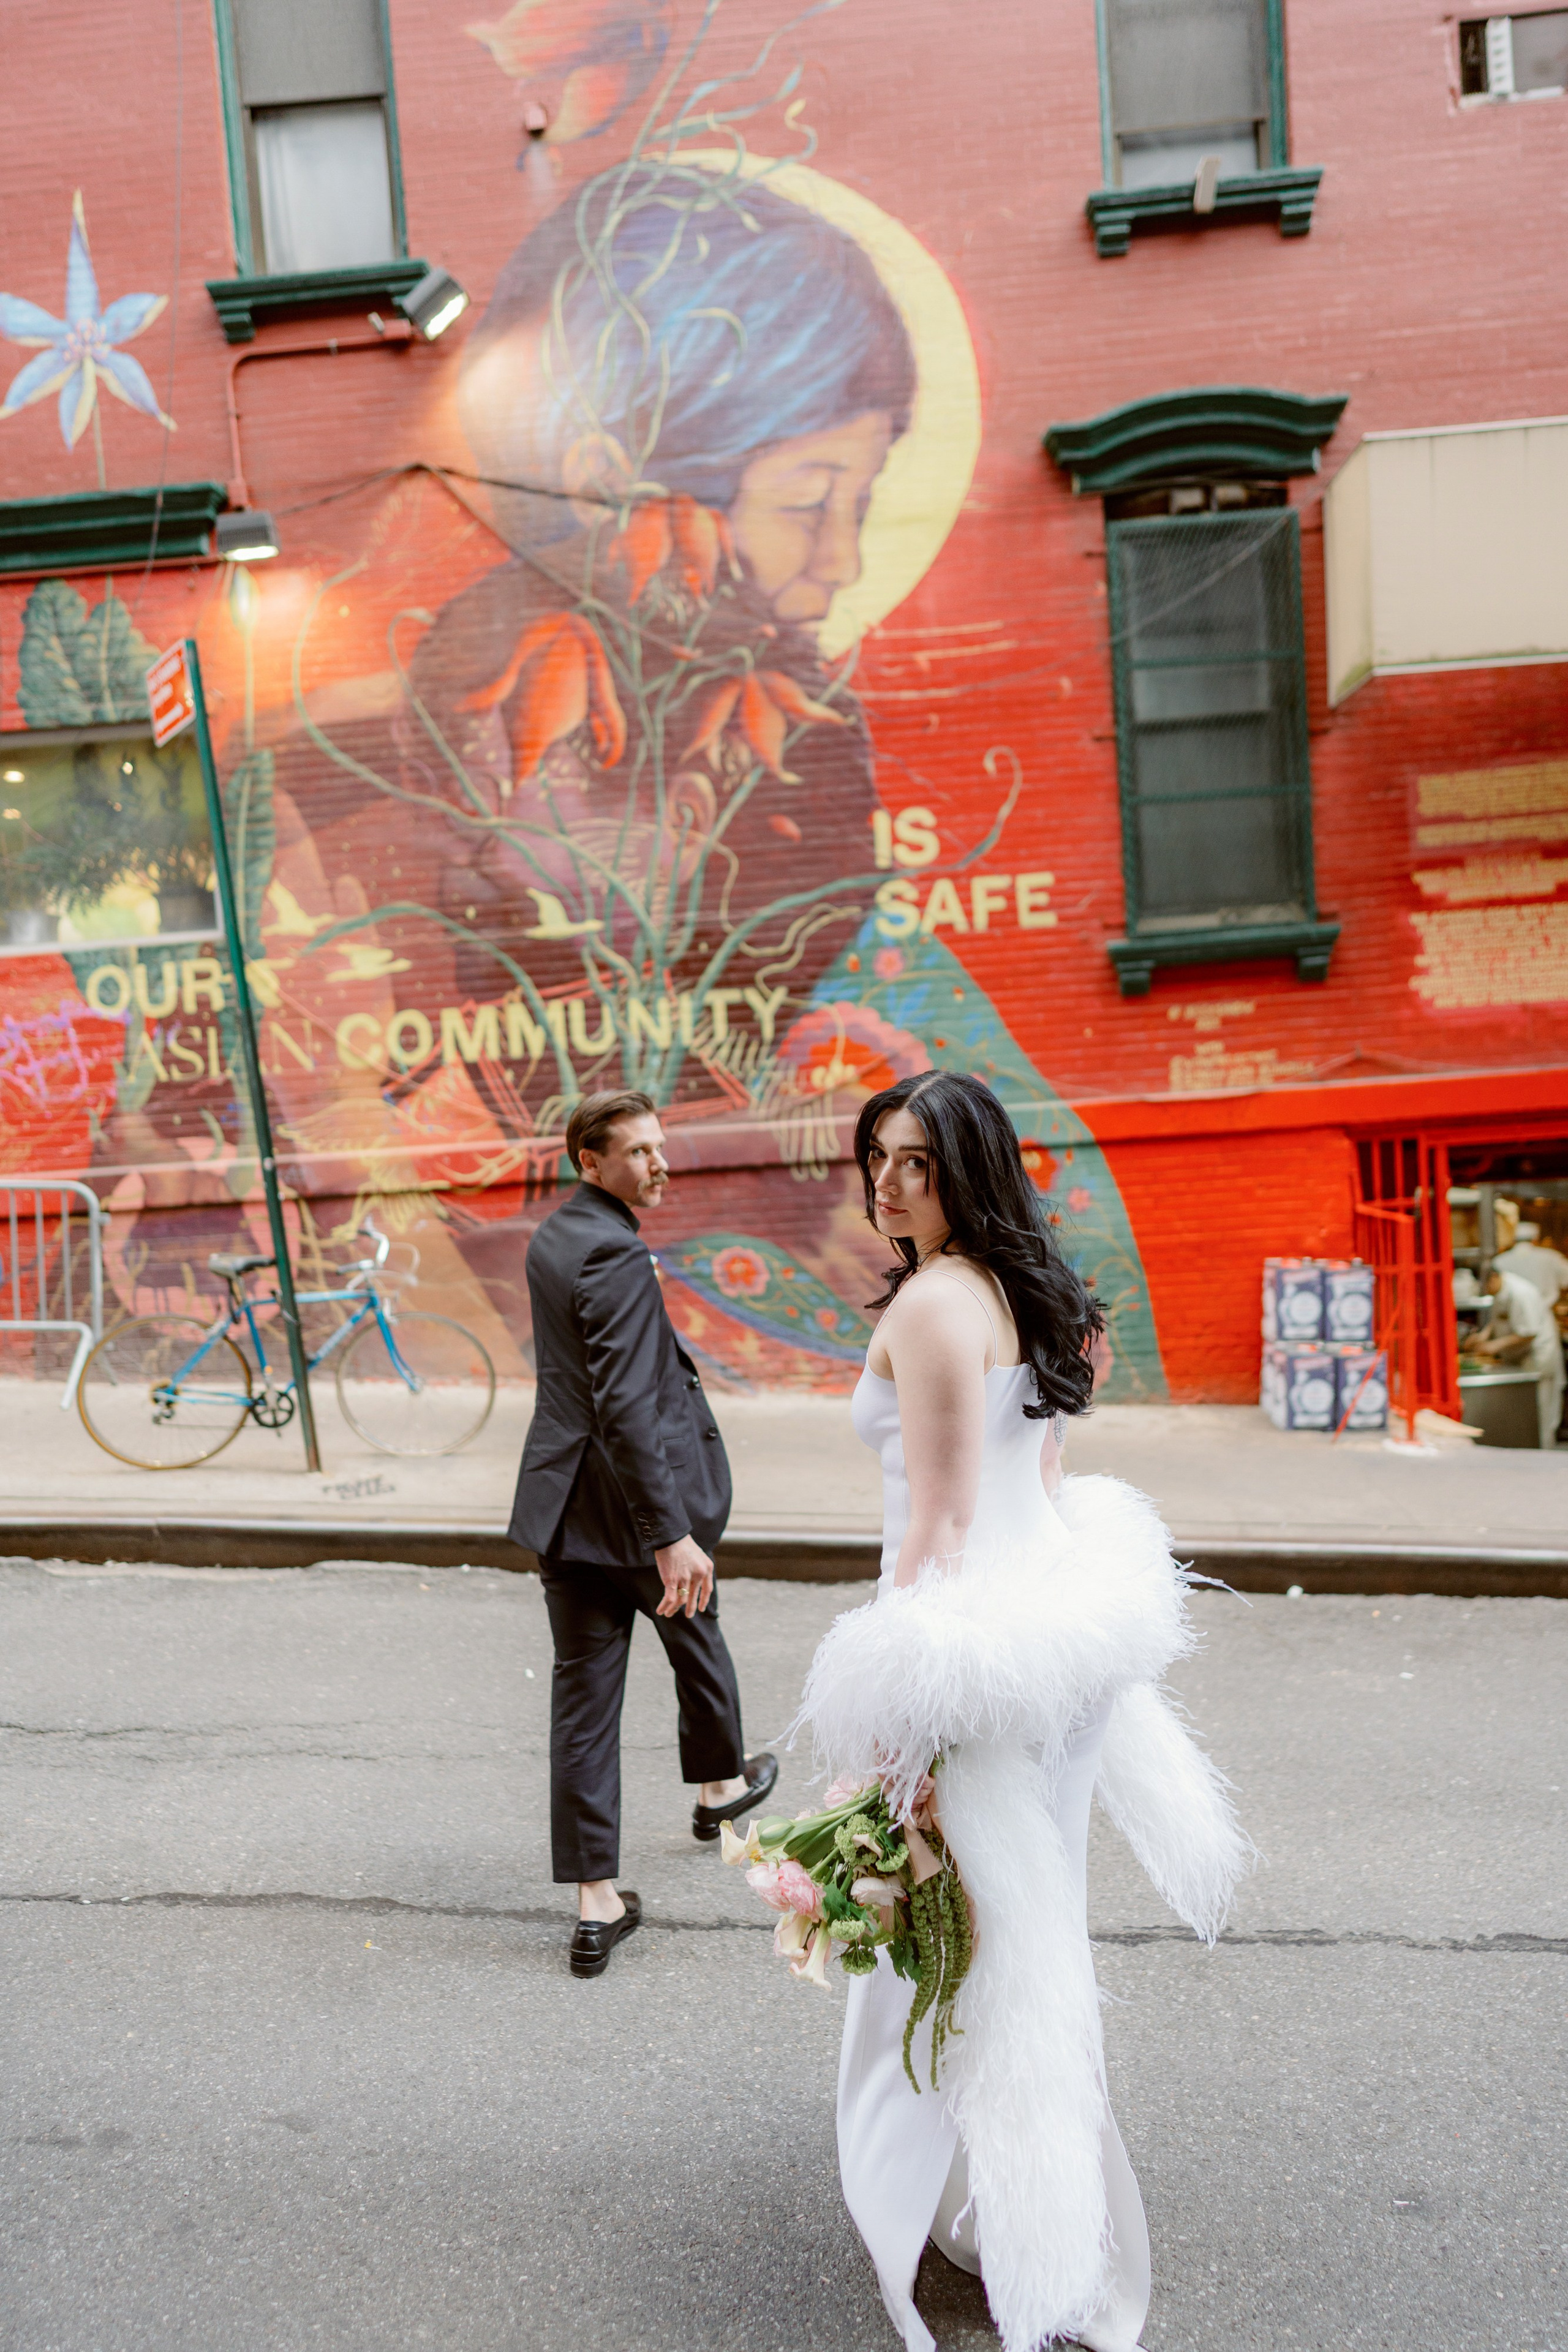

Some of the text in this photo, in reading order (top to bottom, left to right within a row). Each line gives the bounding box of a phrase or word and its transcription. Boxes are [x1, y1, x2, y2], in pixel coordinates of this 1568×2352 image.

[872, 805, 941, 870] IS
[873, 870, 1059, 938] SAFE
[86, 957, 225, 1019] OUR
[335, 985, 790, 1071] COMMUNITY
